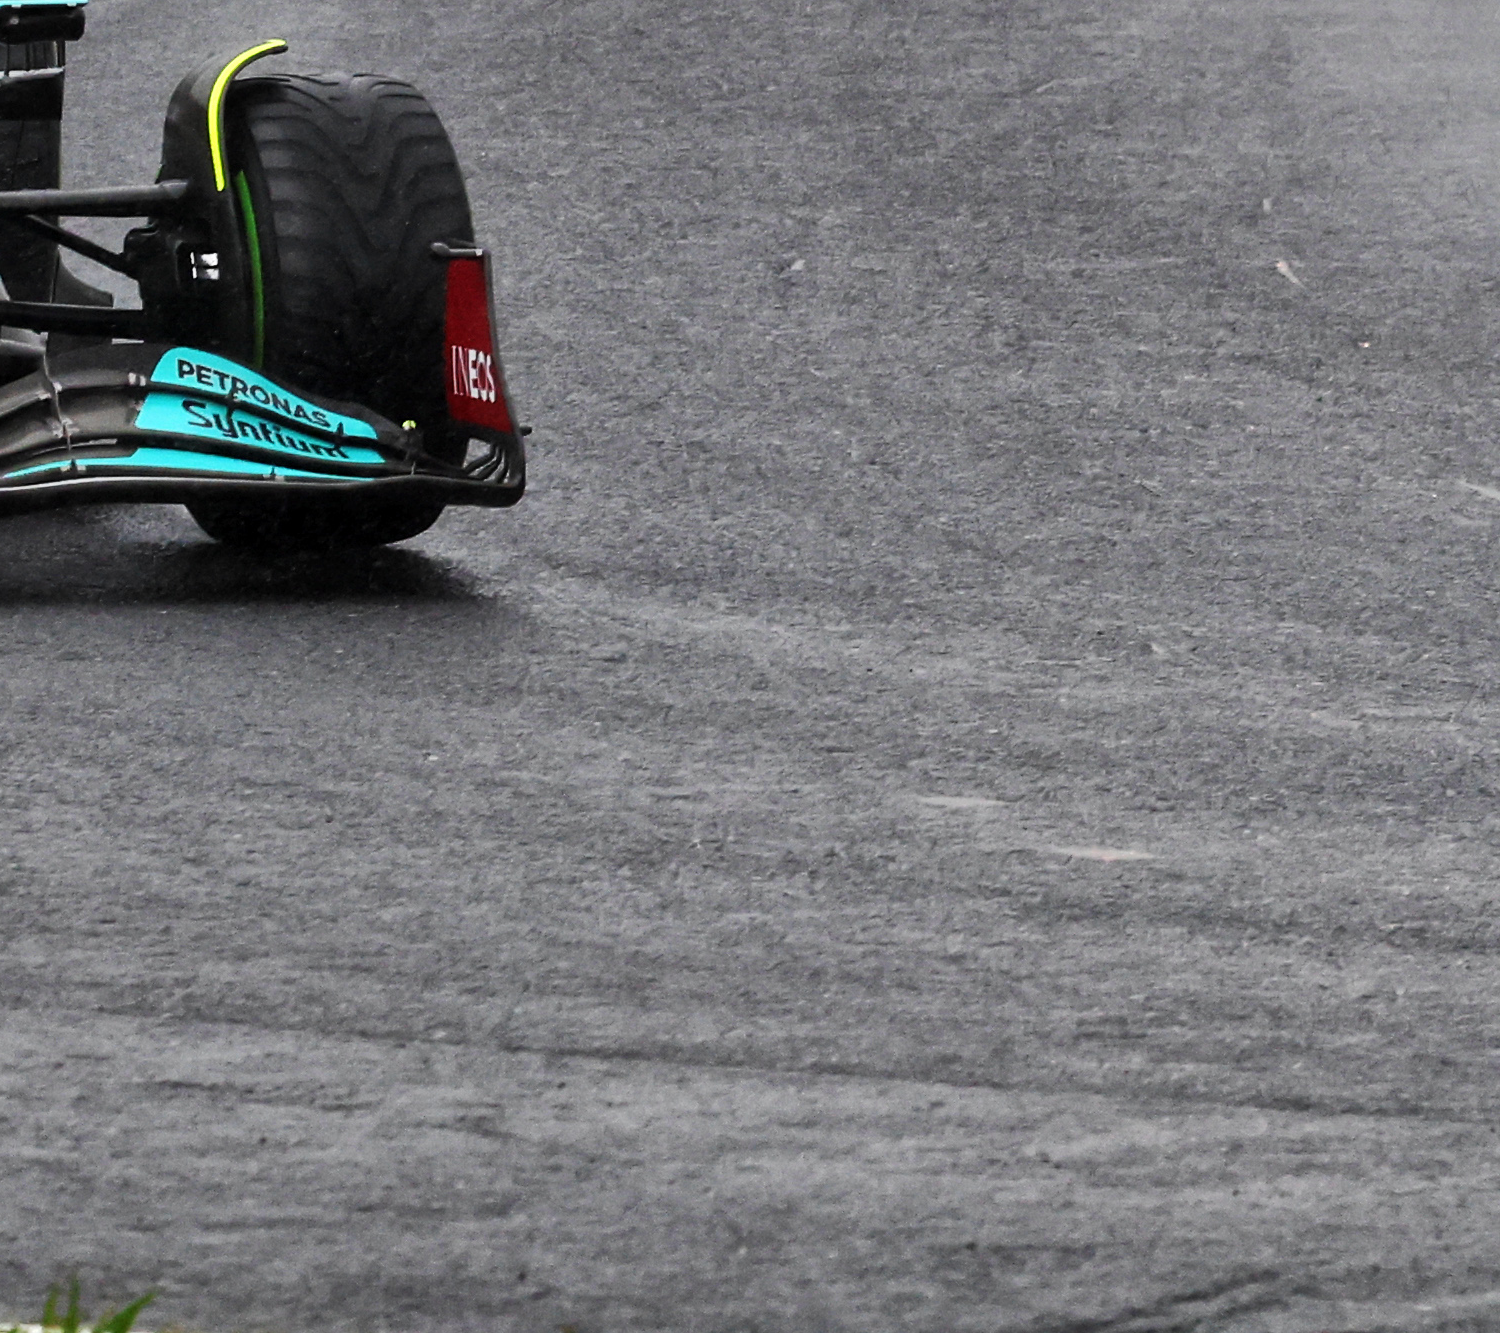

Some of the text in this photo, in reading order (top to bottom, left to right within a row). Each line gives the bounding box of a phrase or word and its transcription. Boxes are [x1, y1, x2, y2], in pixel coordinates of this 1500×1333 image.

[177, 357, 331, 431] PETRONAS
[451, 345, 496, 403] INEOS
[182, 398, 349, 461] Syntium
